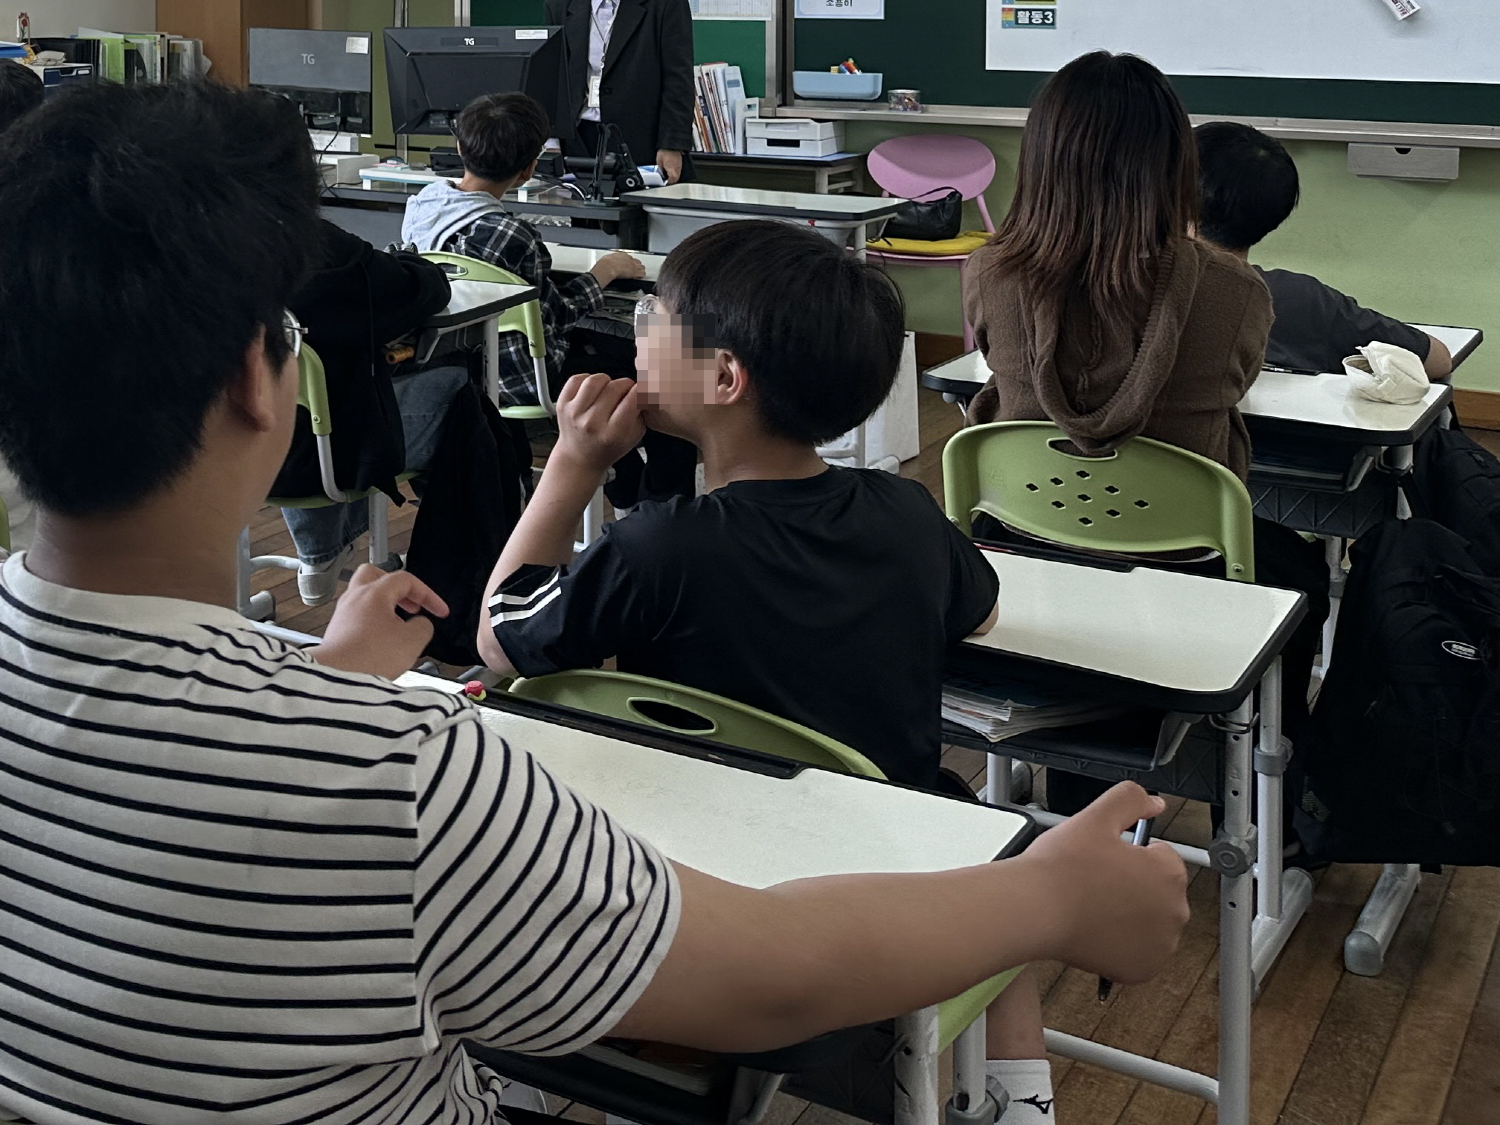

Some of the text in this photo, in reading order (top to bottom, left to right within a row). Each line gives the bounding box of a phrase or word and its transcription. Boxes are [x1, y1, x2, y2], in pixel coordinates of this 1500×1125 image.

[1017, 10, 1053, 24] 활동3
[464, 37, 475, 46] TG
[301, 53, 315, 65] TG
